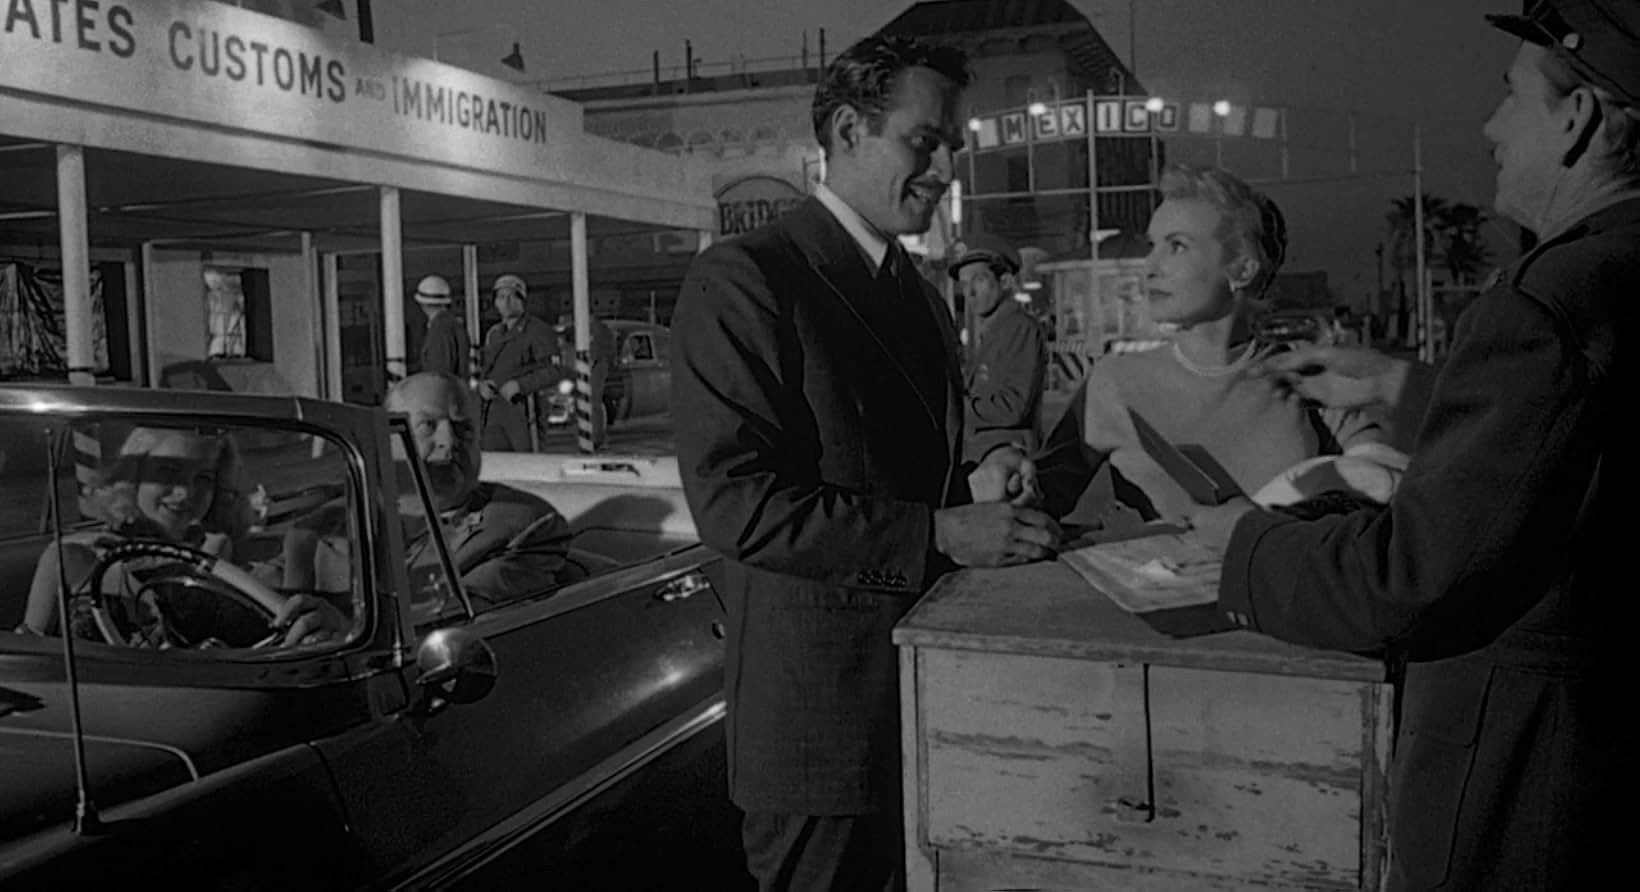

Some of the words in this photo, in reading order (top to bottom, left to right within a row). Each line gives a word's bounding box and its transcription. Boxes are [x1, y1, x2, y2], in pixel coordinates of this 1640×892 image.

[5, 0, 135, 58] ATES
[168, 20, 346, 103] CUSTOMS
[355, 77, 386, 101] AND
[392, 75, 547, 144] IMMIGRATION
[1005, 102, 1178, 142] MEXICO
